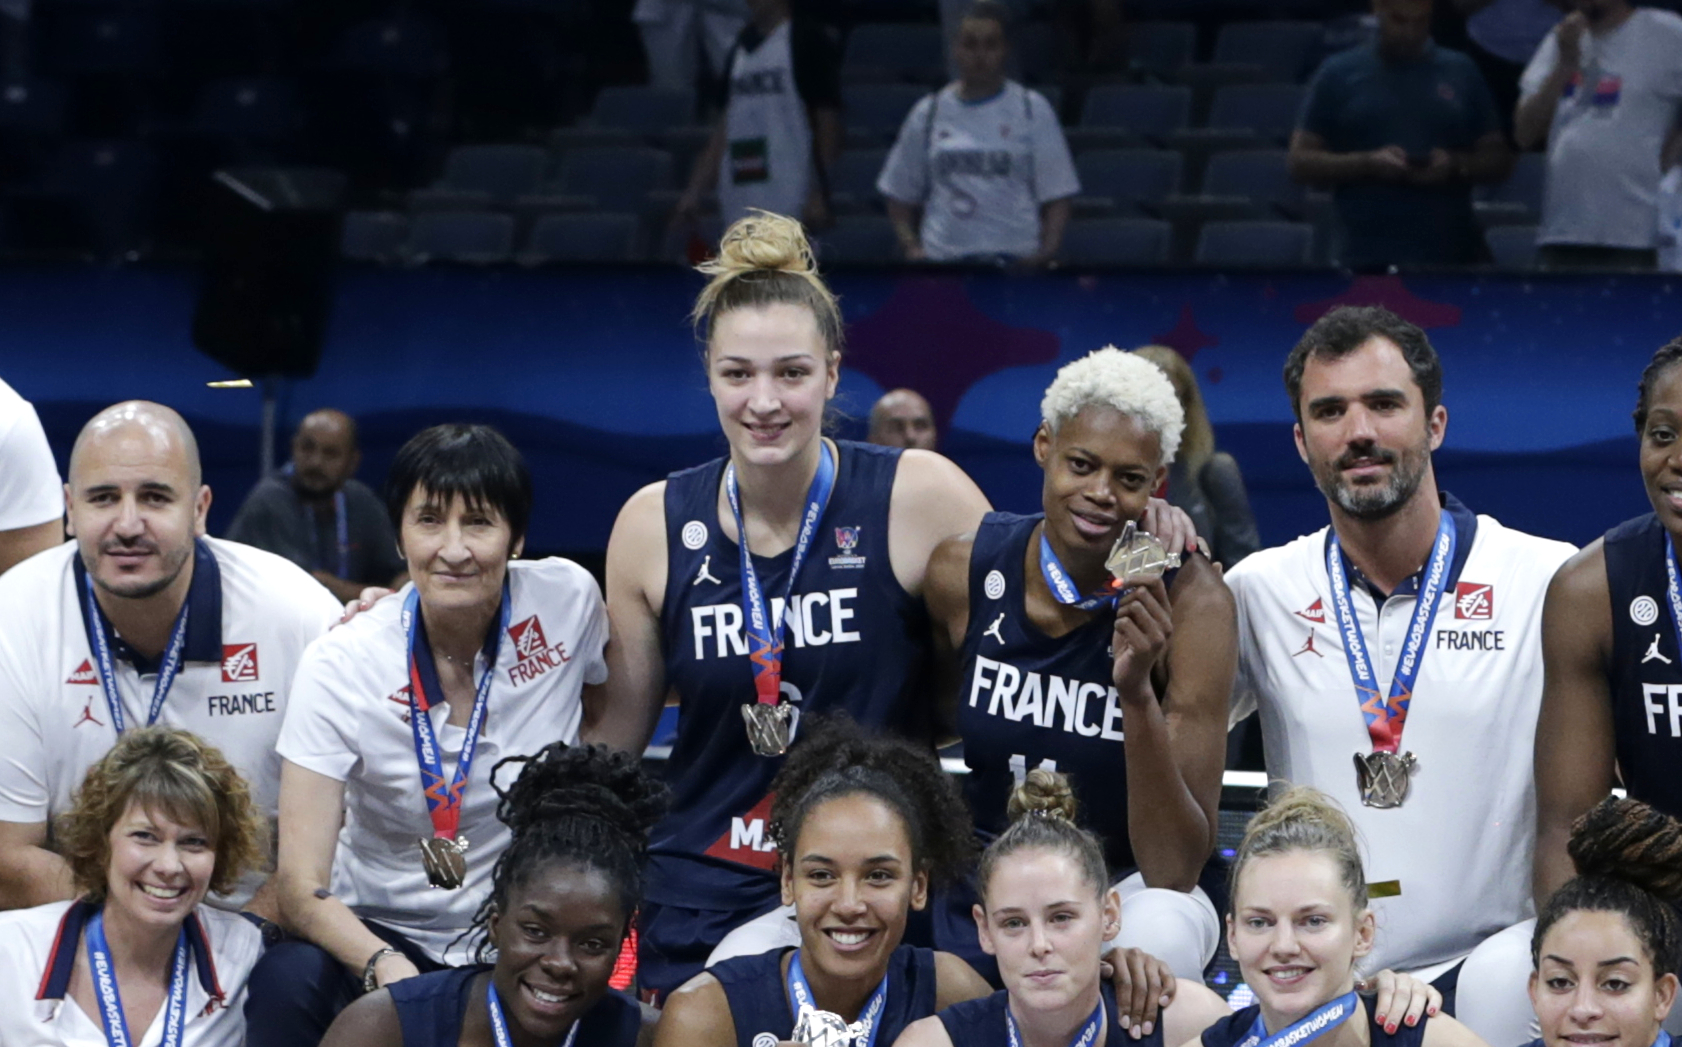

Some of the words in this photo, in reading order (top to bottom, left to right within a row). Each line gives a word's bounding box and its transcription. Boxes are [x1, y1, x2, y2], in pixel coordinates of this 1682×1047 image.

[691, 588, 860, 659] FRNCE
[1330, 543, 1369, 680] #EUROBASKETWOMEN
[1401, 533, 1450, 675] #EUROBASKETWOMEN
[508, 642, 570, 687] FRANCE
[1436, 630, 1505, 651] FRANCE
[208, 692, 276, 717] FRANCE
